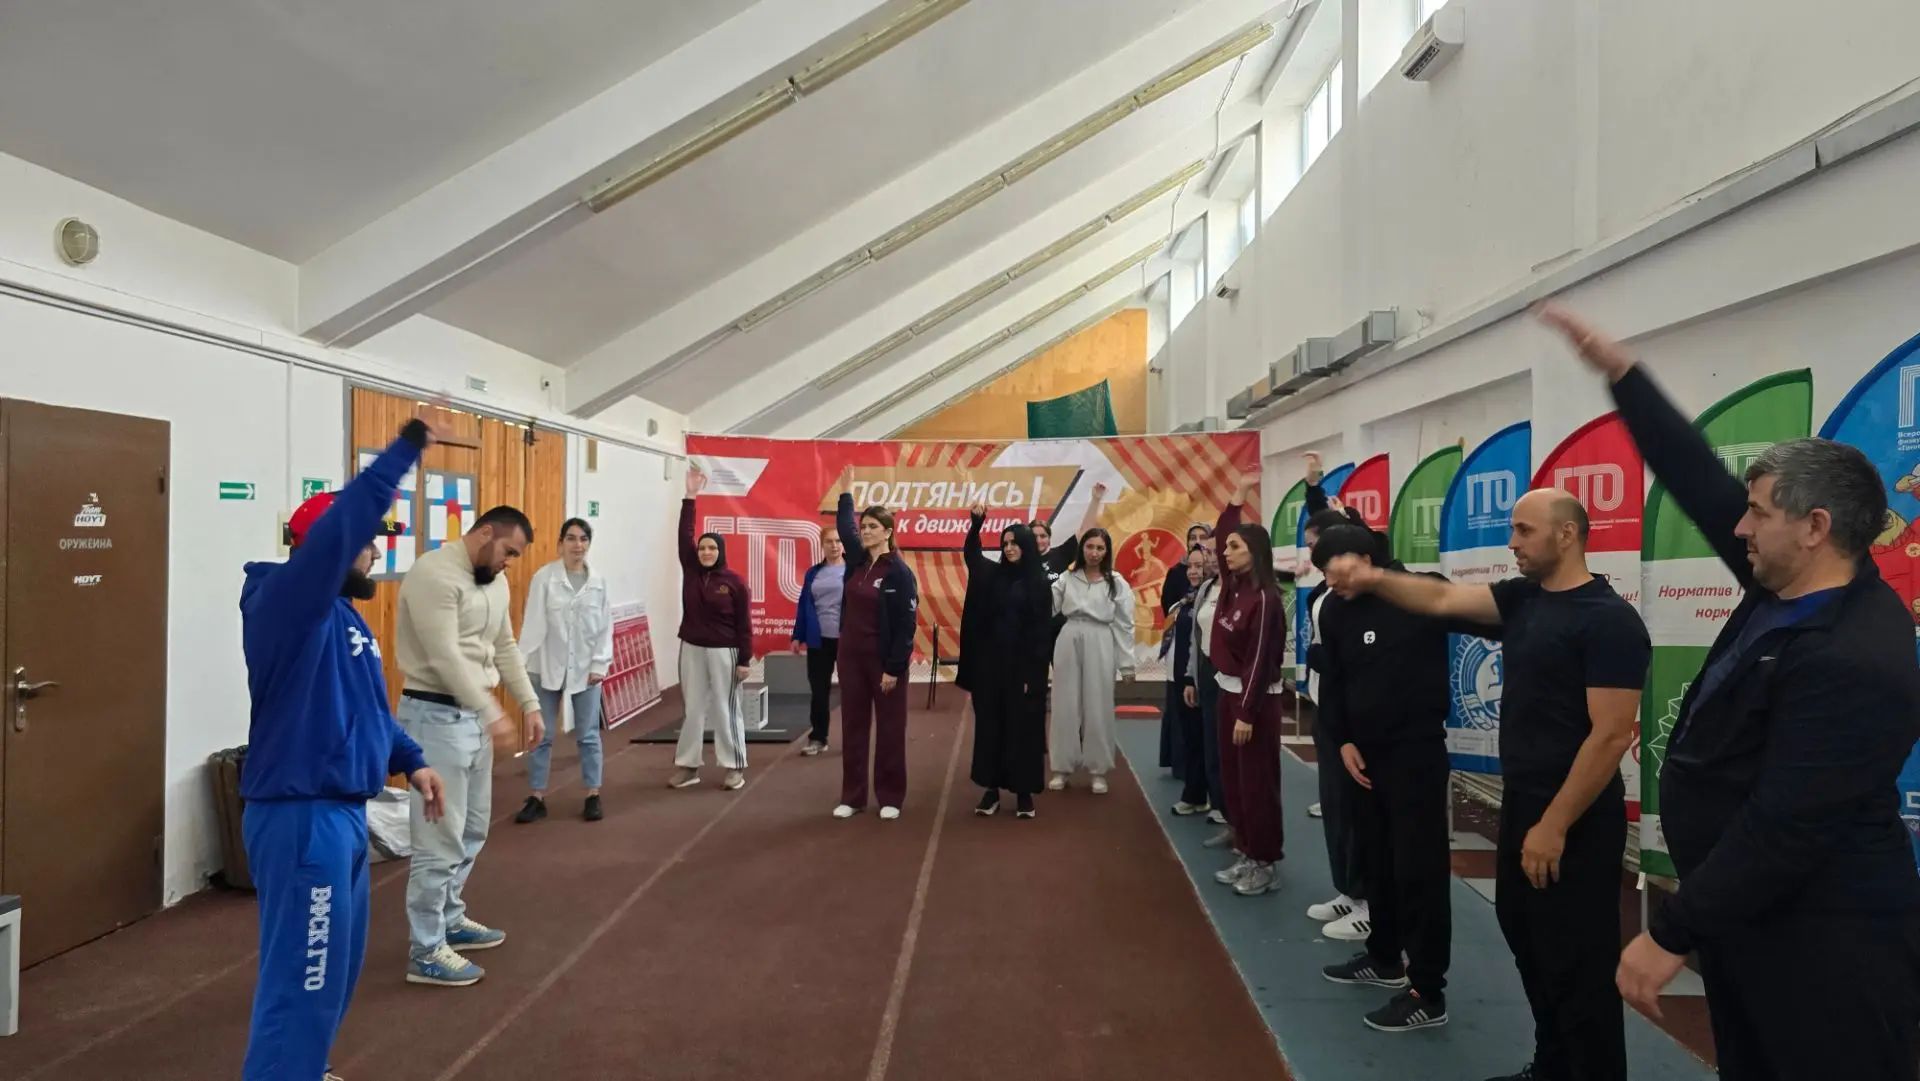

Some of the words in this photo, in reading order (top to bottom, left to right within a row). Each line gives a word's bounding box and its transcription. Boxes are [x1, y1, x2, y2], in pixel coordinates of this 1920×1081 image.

[851, 480, 1025, 511] ПОДТЯНИСЬ
[1466, 469, 1517, 515] ГТО
[1346, 489, 1382, 521] ГТО
[896, 518, 911, 533] к
[914, 514, 1022, 534] движни
[1491, 564, 1508, 573] ГТО
[73, 574, 103, 584] HOYT
[1658, 584, 1733, 601] Норматив
[1695, 606, 1733, 620] норм
[304, 947, 328, 990] ГТО
